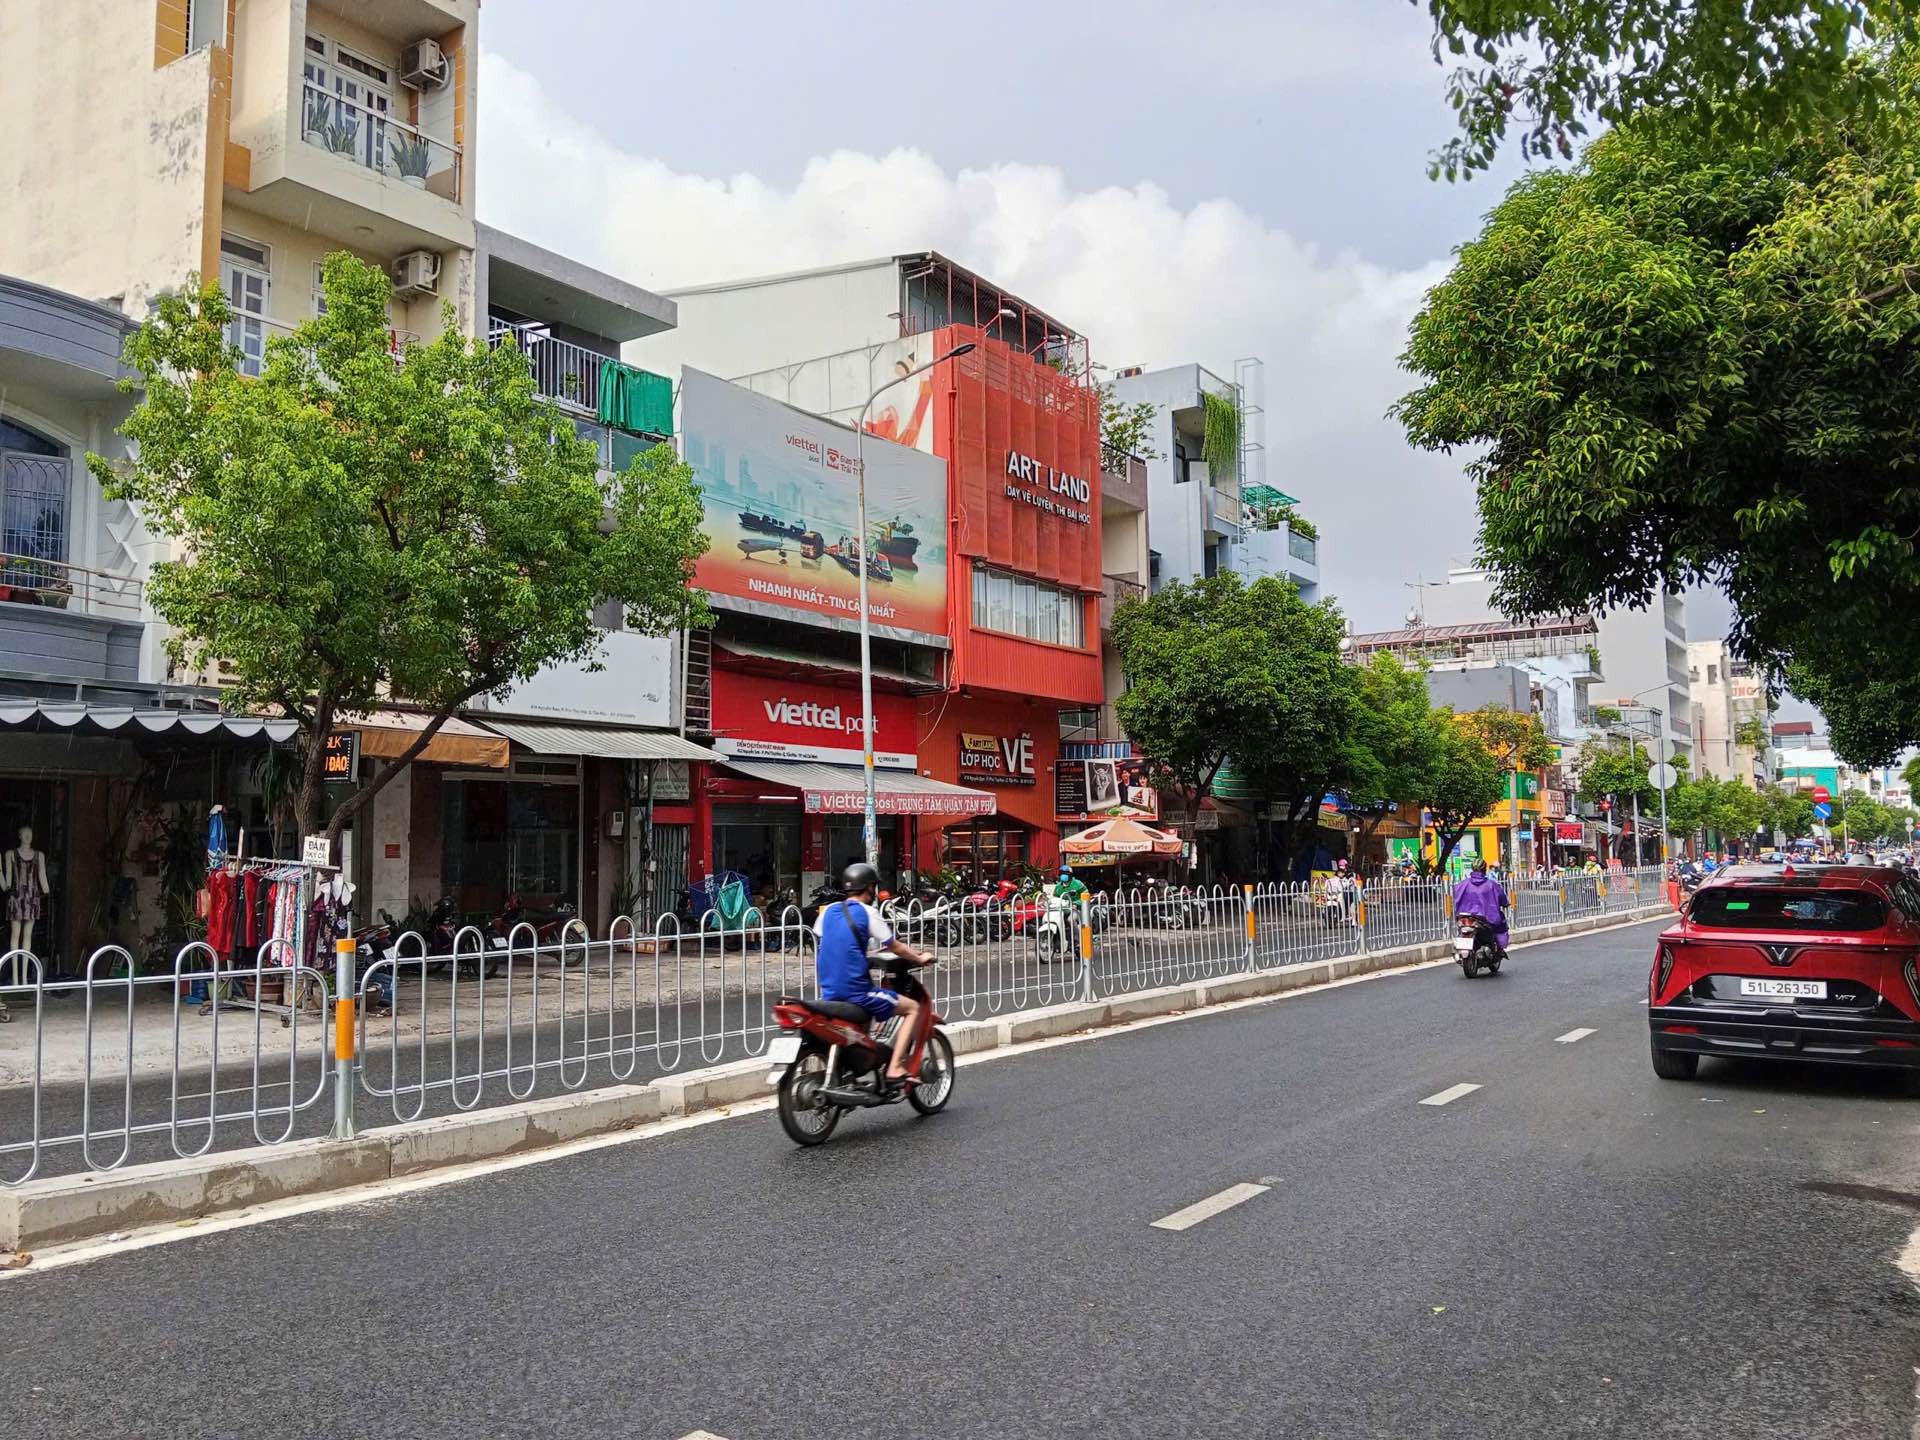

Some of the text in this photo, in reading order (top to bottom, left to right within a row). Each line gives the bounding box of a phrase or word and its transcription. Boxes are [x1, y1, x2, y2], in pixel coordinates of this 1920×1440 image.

[786, 434, 819, 454] viettel
[1007, 451, 1090, 503] ART LAND
[1007, 486, 1020, 500] DẠY
[1022, 490, 1031, 503] VẼ
[1056, 503, 1066, 516] THI
[1079, 513, 1090, 526] HỌC
[748, 578, 791, 598] NHANH
[793, 587, 823, 606] NHẤT
[829, 595, 846, 610] TIN
[848, 599, 861, 615] CẬ
[869, 601, 896, 618] NHẤT
[763, 697, 879, 735] viettel pot
[329, 753, 347, 771] ĐÀO
[961, 732, 1035, 774] LỚP HỌC VẼ
[823, 792, 866, 808] viette
[897, 798, 923, 811] TRUNG
[925, 796, 941, 811] TÂM
[965, 796, 978, 812] TÂN
